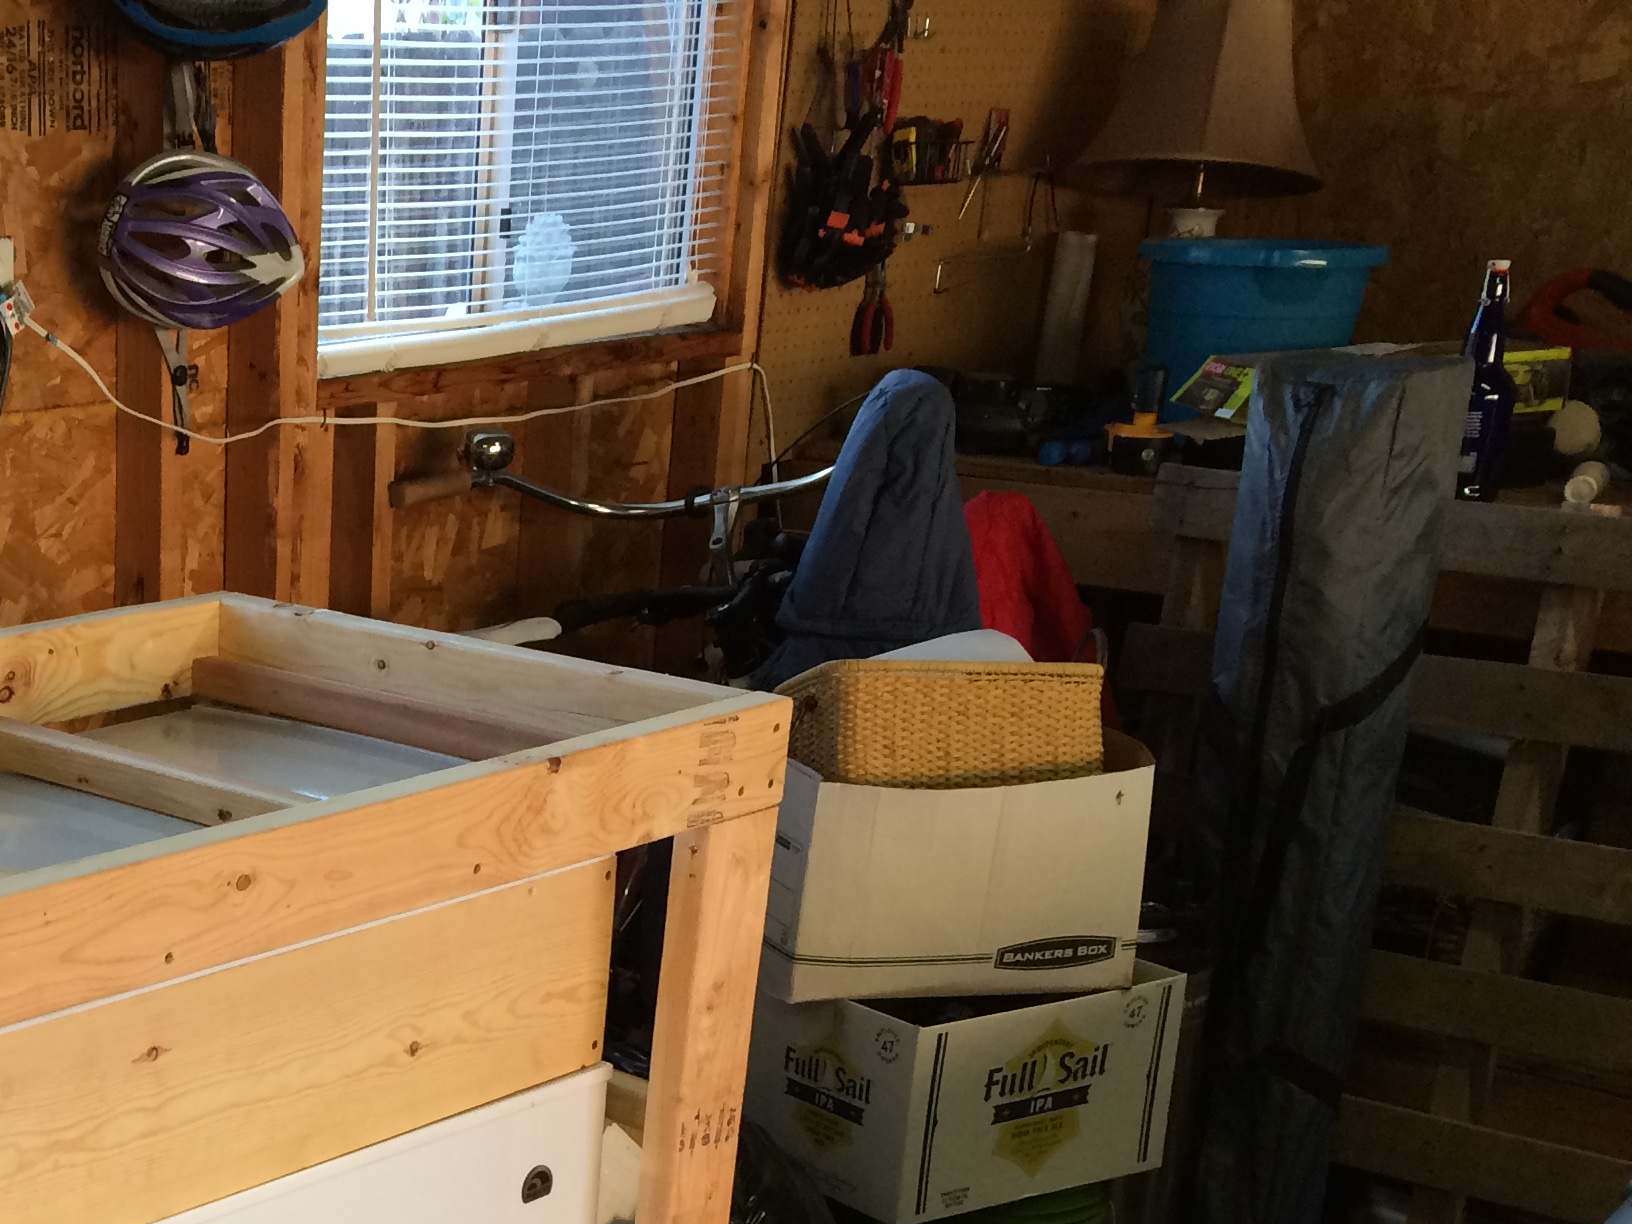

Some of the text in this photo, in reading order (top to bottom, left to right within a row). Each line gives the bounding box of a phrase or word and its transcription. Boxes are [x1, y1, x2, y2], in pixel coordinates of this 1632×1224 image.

[5, 26, 17, 75] 24/16
[27, 58, 37, 97] APA
[71, 25, 87, 131] norbord
[47, 89, 55, 128] DOWN
[1002, 944, 1108, 963] BANKERS BOX
[1128, 1005, 1143, 1019] 47
[880, 1040, 894, 1053] 47
[784, 1045, 820, 1083] Full
[835, 1066, 871, 1105] Sail
[984, 1043, 1109, 1102] Full Sail
[814, 1092, 834, 1111] IPA
[1029, 1096, 1053, 1114] IPA
